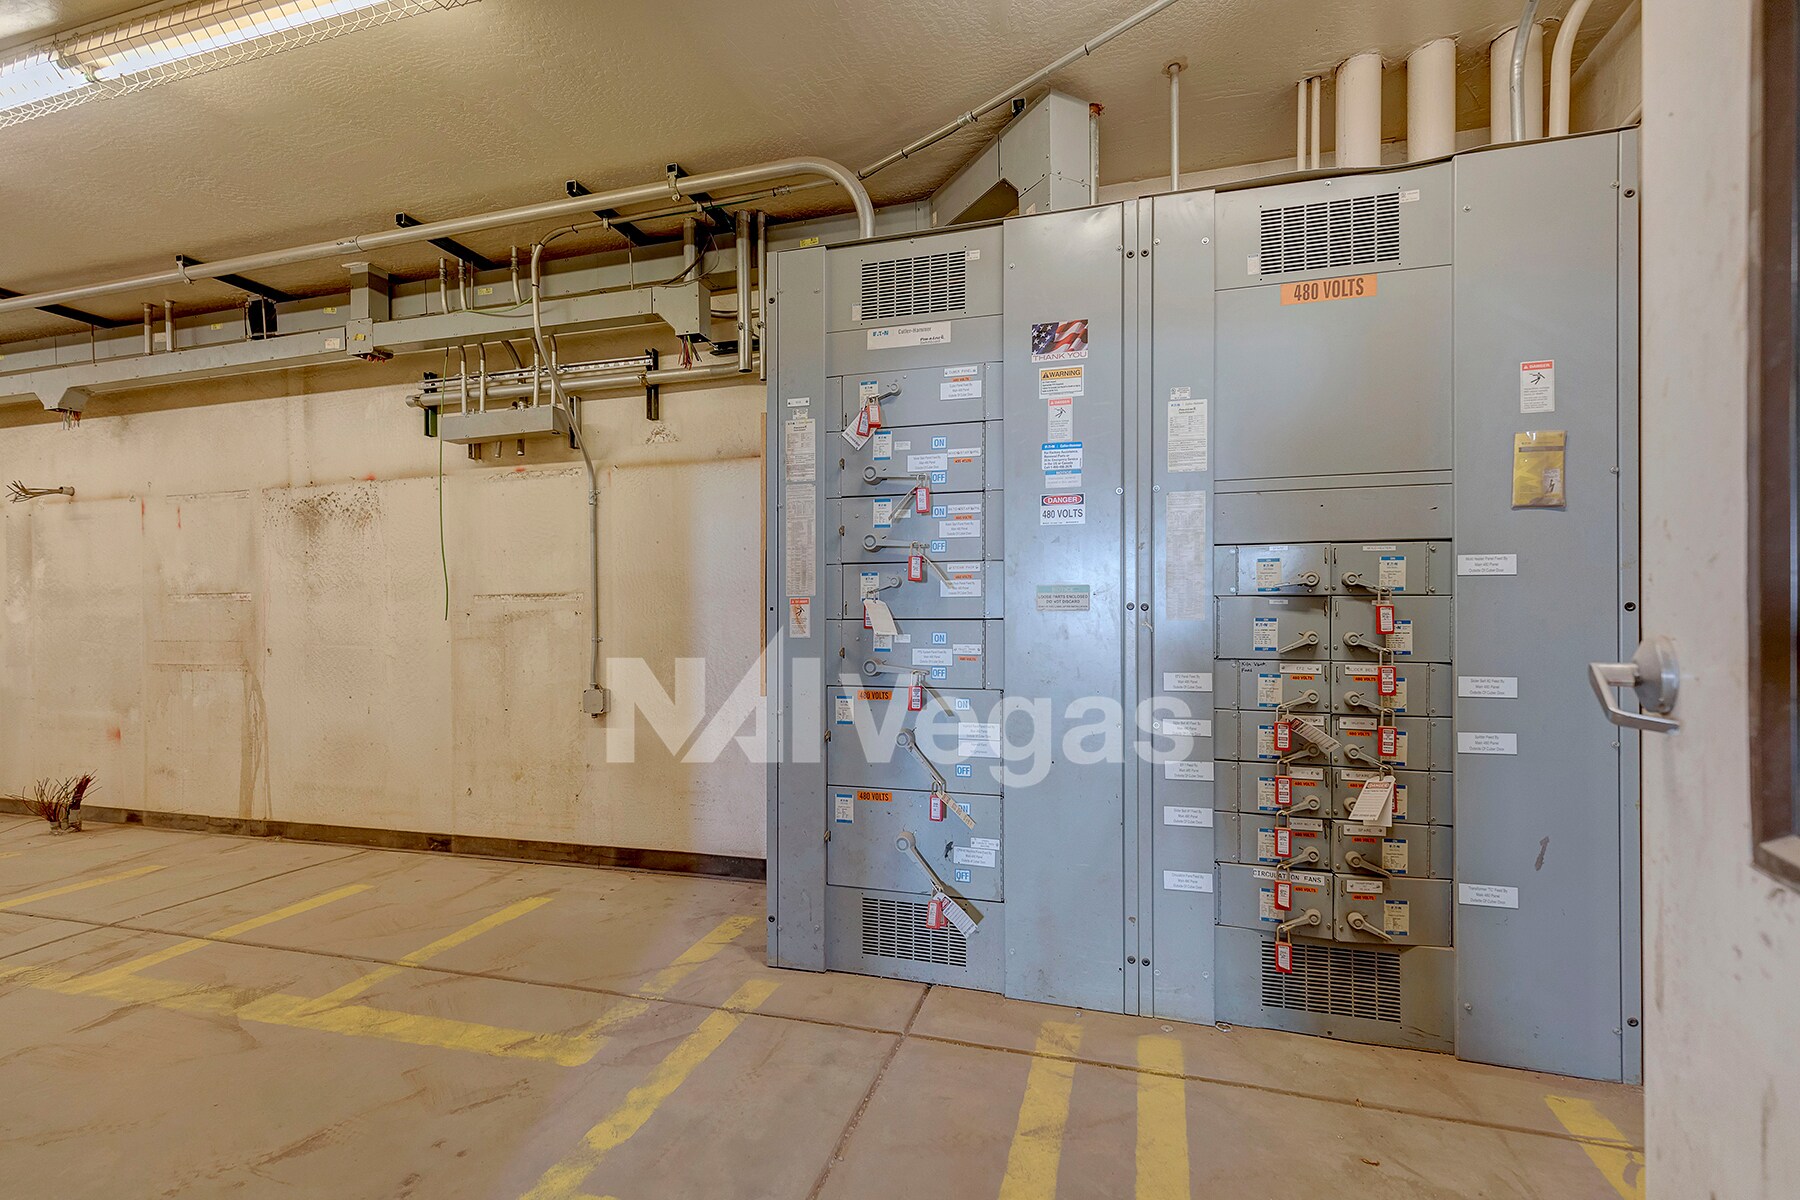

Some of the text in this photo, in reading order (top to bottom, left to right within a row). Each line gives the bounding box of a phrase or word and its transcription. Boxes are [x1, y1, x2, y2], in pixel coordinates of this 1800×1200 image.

[1294, 278, 1364, 300] 480 VOLTS
[1049, 370, 1081, 378] WARNING
[1042, 509, 1083, 518] 480 VOLTS
[871, 691, 889, 699] VOLTS
[872, 793, 888, 801] VOLTS
[1253, 870, 1300, 880] CIRCULATON
